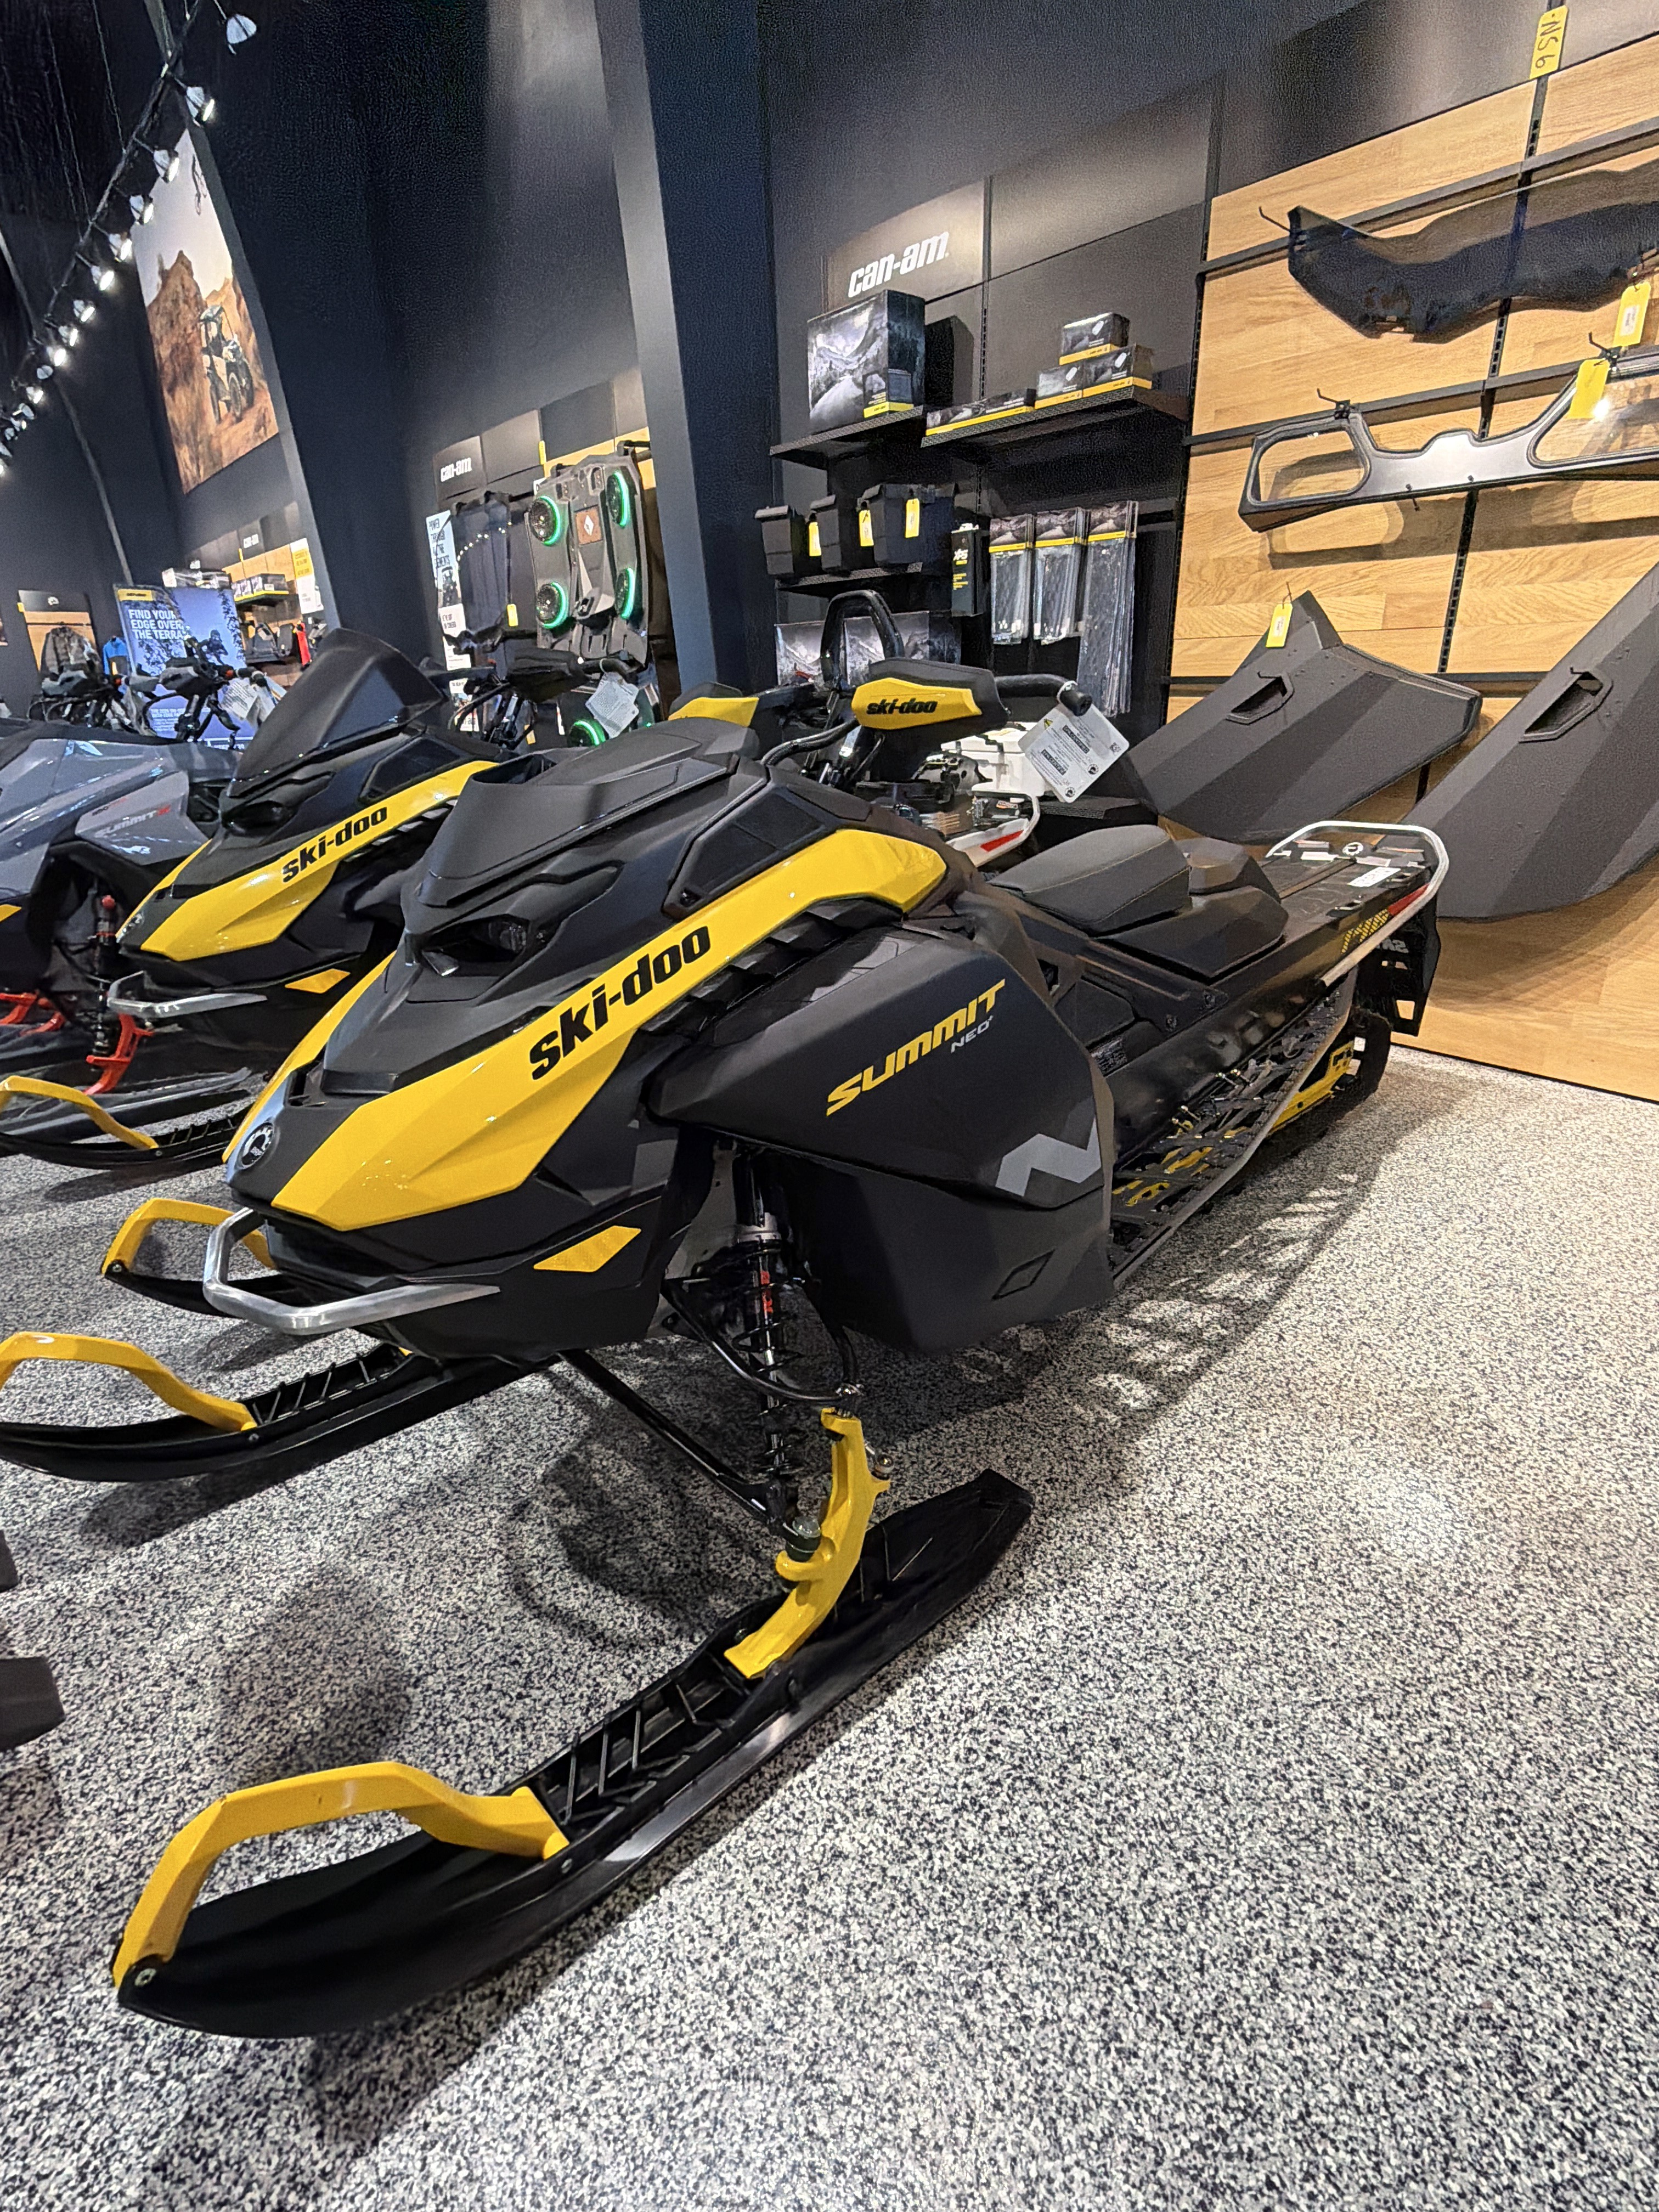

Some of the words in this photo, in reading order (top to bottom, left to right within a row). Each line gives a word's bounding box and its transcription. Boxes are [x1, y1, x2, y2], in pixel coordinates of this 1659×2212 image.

[848, 231, 950, 298] can-am
[440, 457, 472, 483] can-am
[952, 548, 969, 561] XPS
[128, 609, 151, 619] FIND
[131, 619, 156, 629] EDGE
[132, 629, 153, 640] THE
[866, 697, 938, 715] ski-doo
[281, 806, 387, 883] ski-doo
[529, 925, 711, 1081] ski-doo
[826, 978, 1006, 1117] SUMMIT
